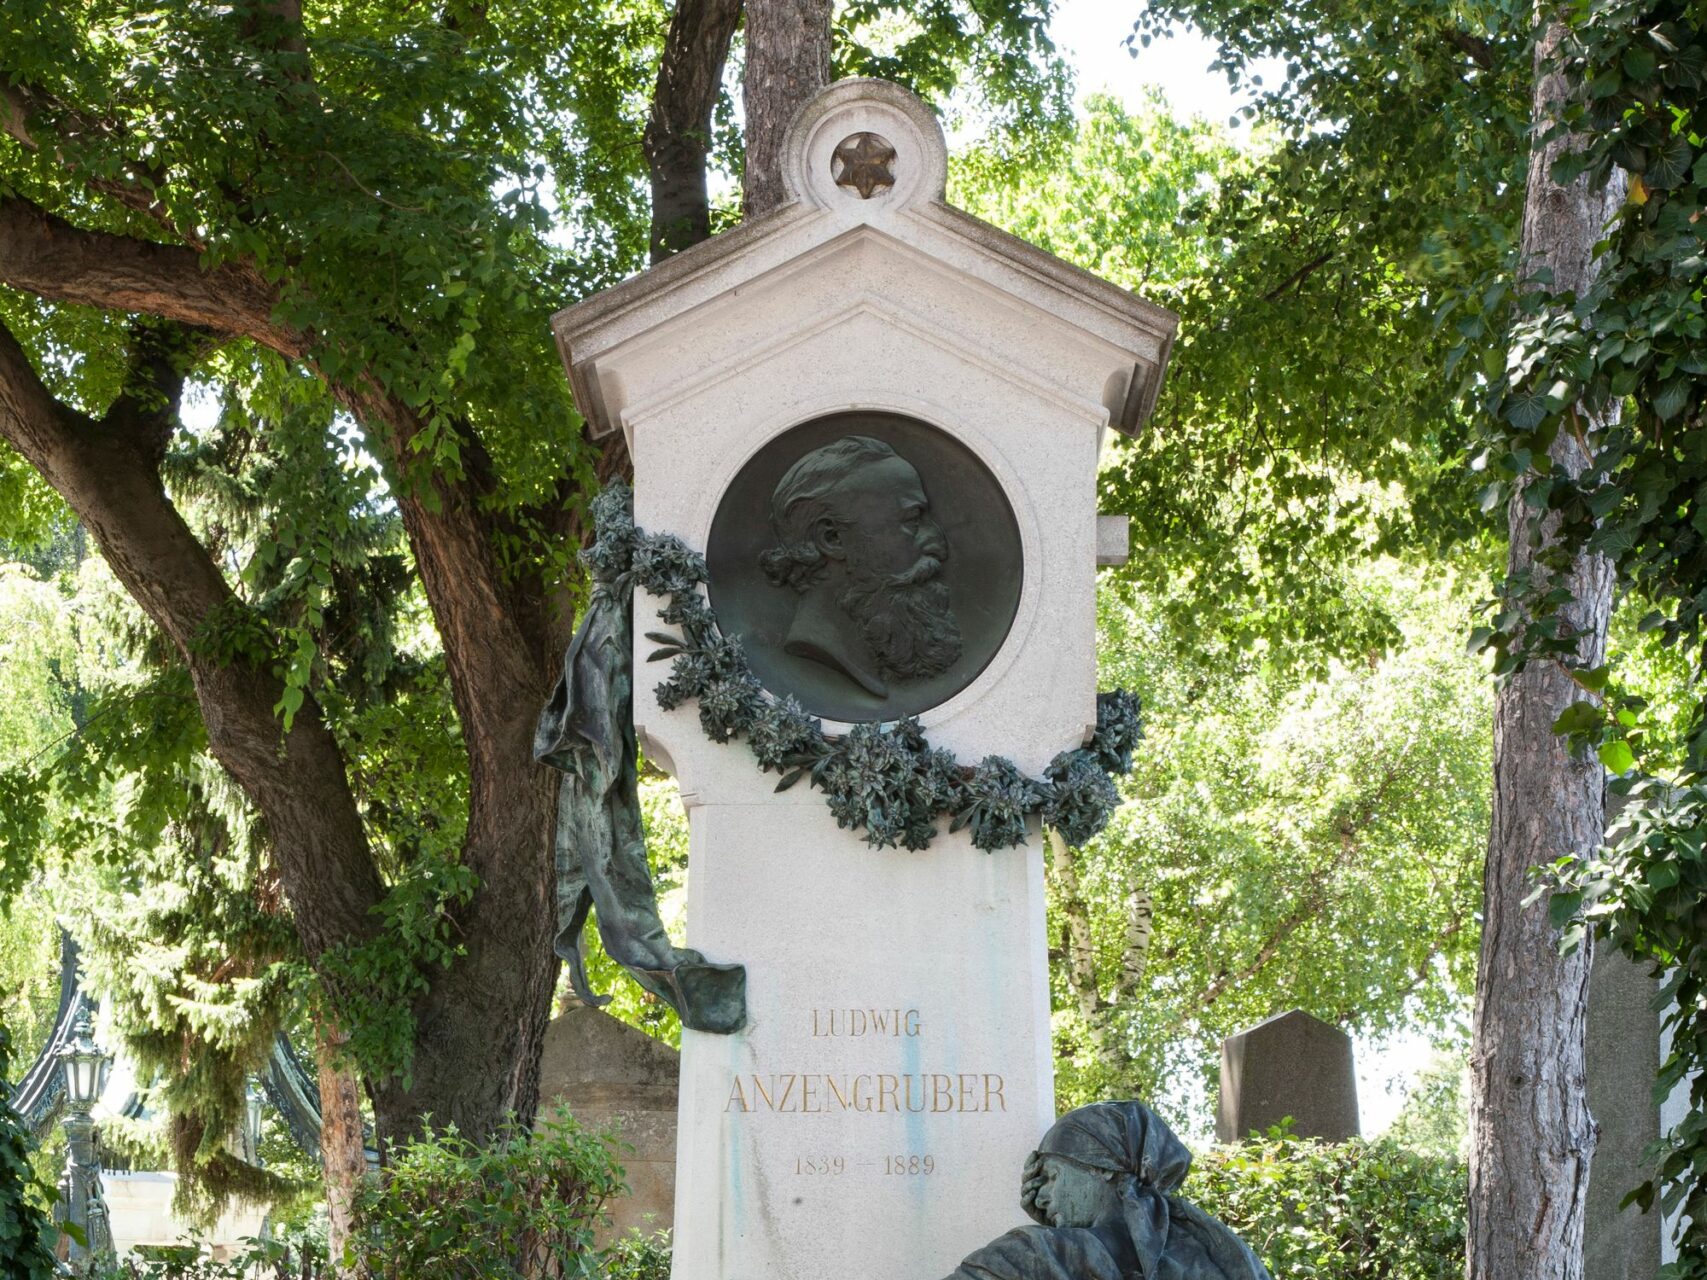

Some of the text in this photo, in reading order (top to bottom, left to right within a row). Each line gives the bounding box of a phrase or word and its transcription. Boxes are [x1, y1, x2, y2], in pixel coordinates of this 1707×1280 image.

[811, 1008, 921, 1037] LUDWIG
[723, 1073, 1008, 1113] ANZENGRUBER
[794, 1155, 845, 1176] 1839
[884, 1154, 935, 1176] 1889
